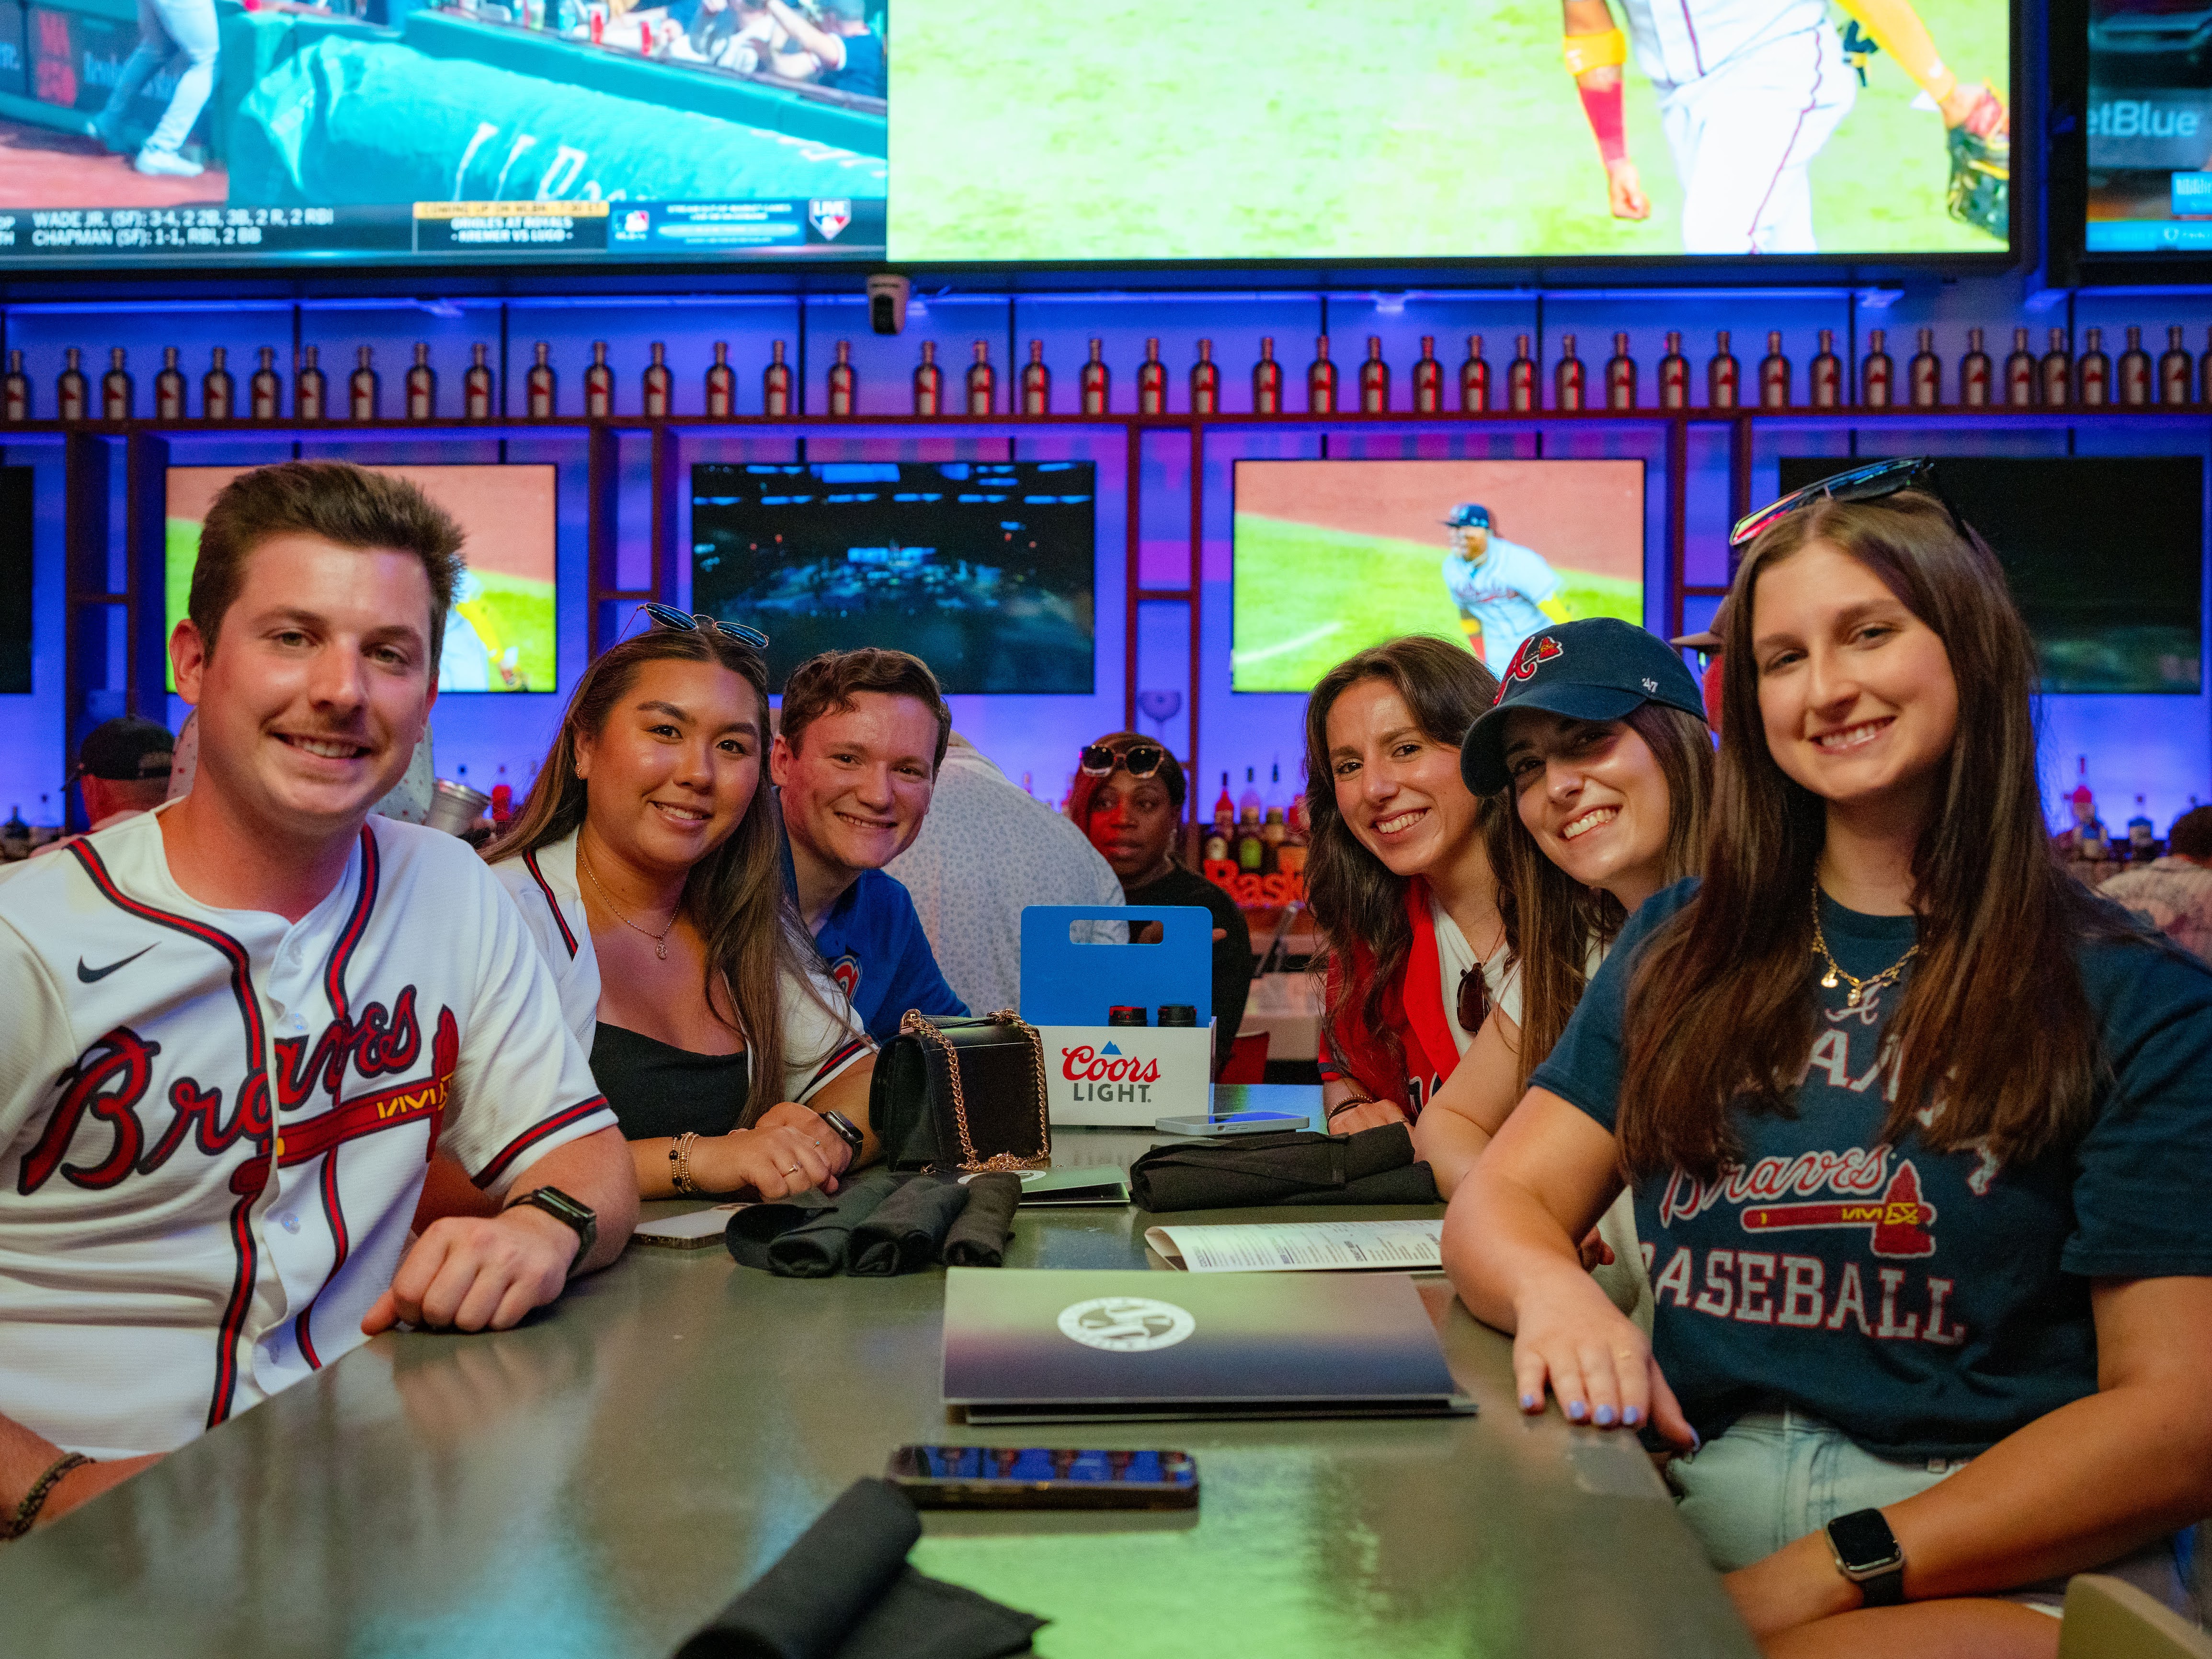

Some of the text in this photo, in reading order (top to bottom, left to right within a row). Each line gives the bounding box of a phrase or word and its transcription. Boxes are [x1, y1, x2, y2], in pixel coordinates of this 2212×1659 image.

[33, 211, 82, 228] WADE
[182, 210, 194, 227] 2
[256, 208, 268, 226] 2
[290, 208, 303, 226] 2
[812, 200, 848, 216] LIVE
[523, 216, 573, 229] ROYALS
[33, 229, 114, 246] CHAPMAN
[223, 227, 235, 245] 2
[1061, 1045, 1161, 1082] Coors
[17, 984, 422, 1196] Braves
[1639, 1240, 1966, 1345] ASEBALL
